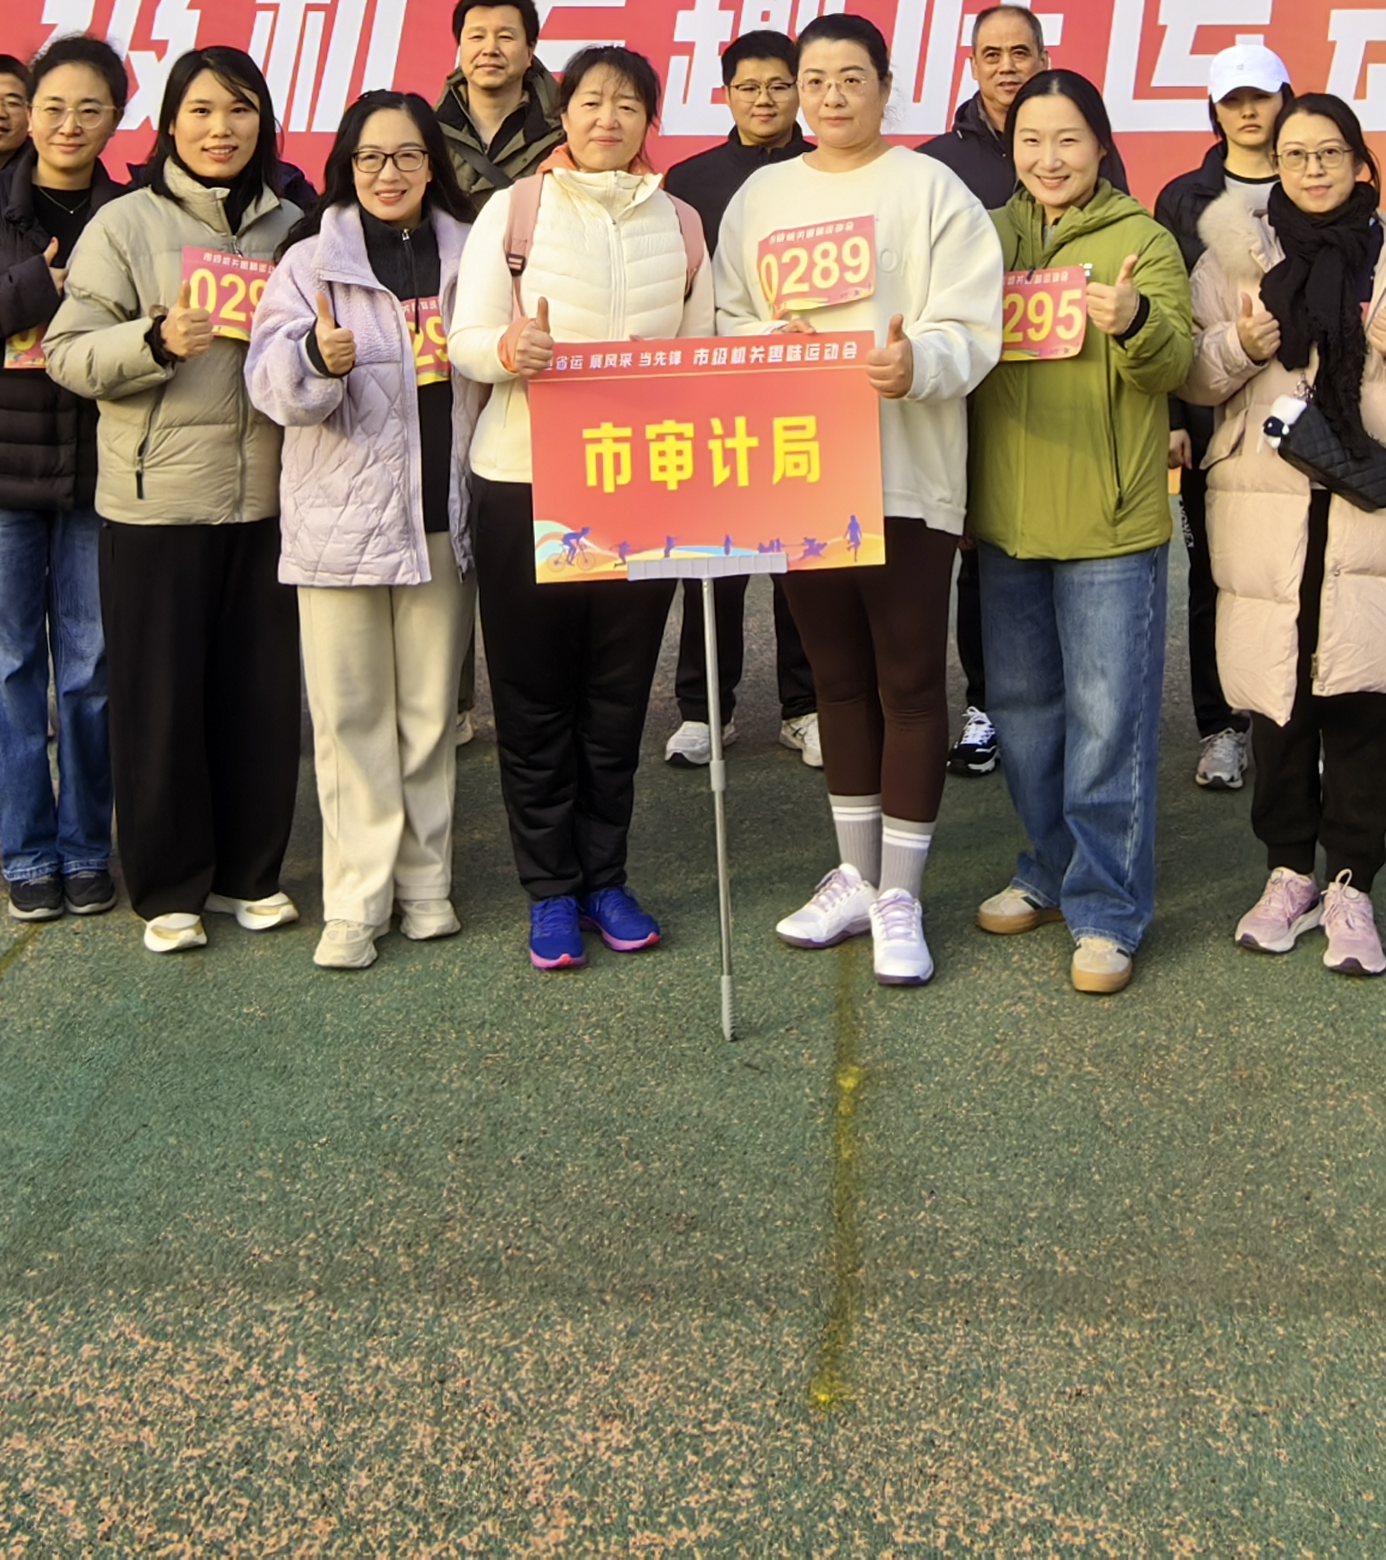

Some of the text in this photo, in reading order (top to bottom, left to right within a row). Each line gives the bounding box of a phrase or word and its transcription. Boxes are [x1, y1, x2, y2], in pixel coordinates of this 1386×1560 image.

[760, 236, 870, 304] 0289
[589, 353, 633, 369] 展风采
[693, 342, 858, 366] 市级机关趣味运动会
[582, 415, 821, 493] 市审计局
